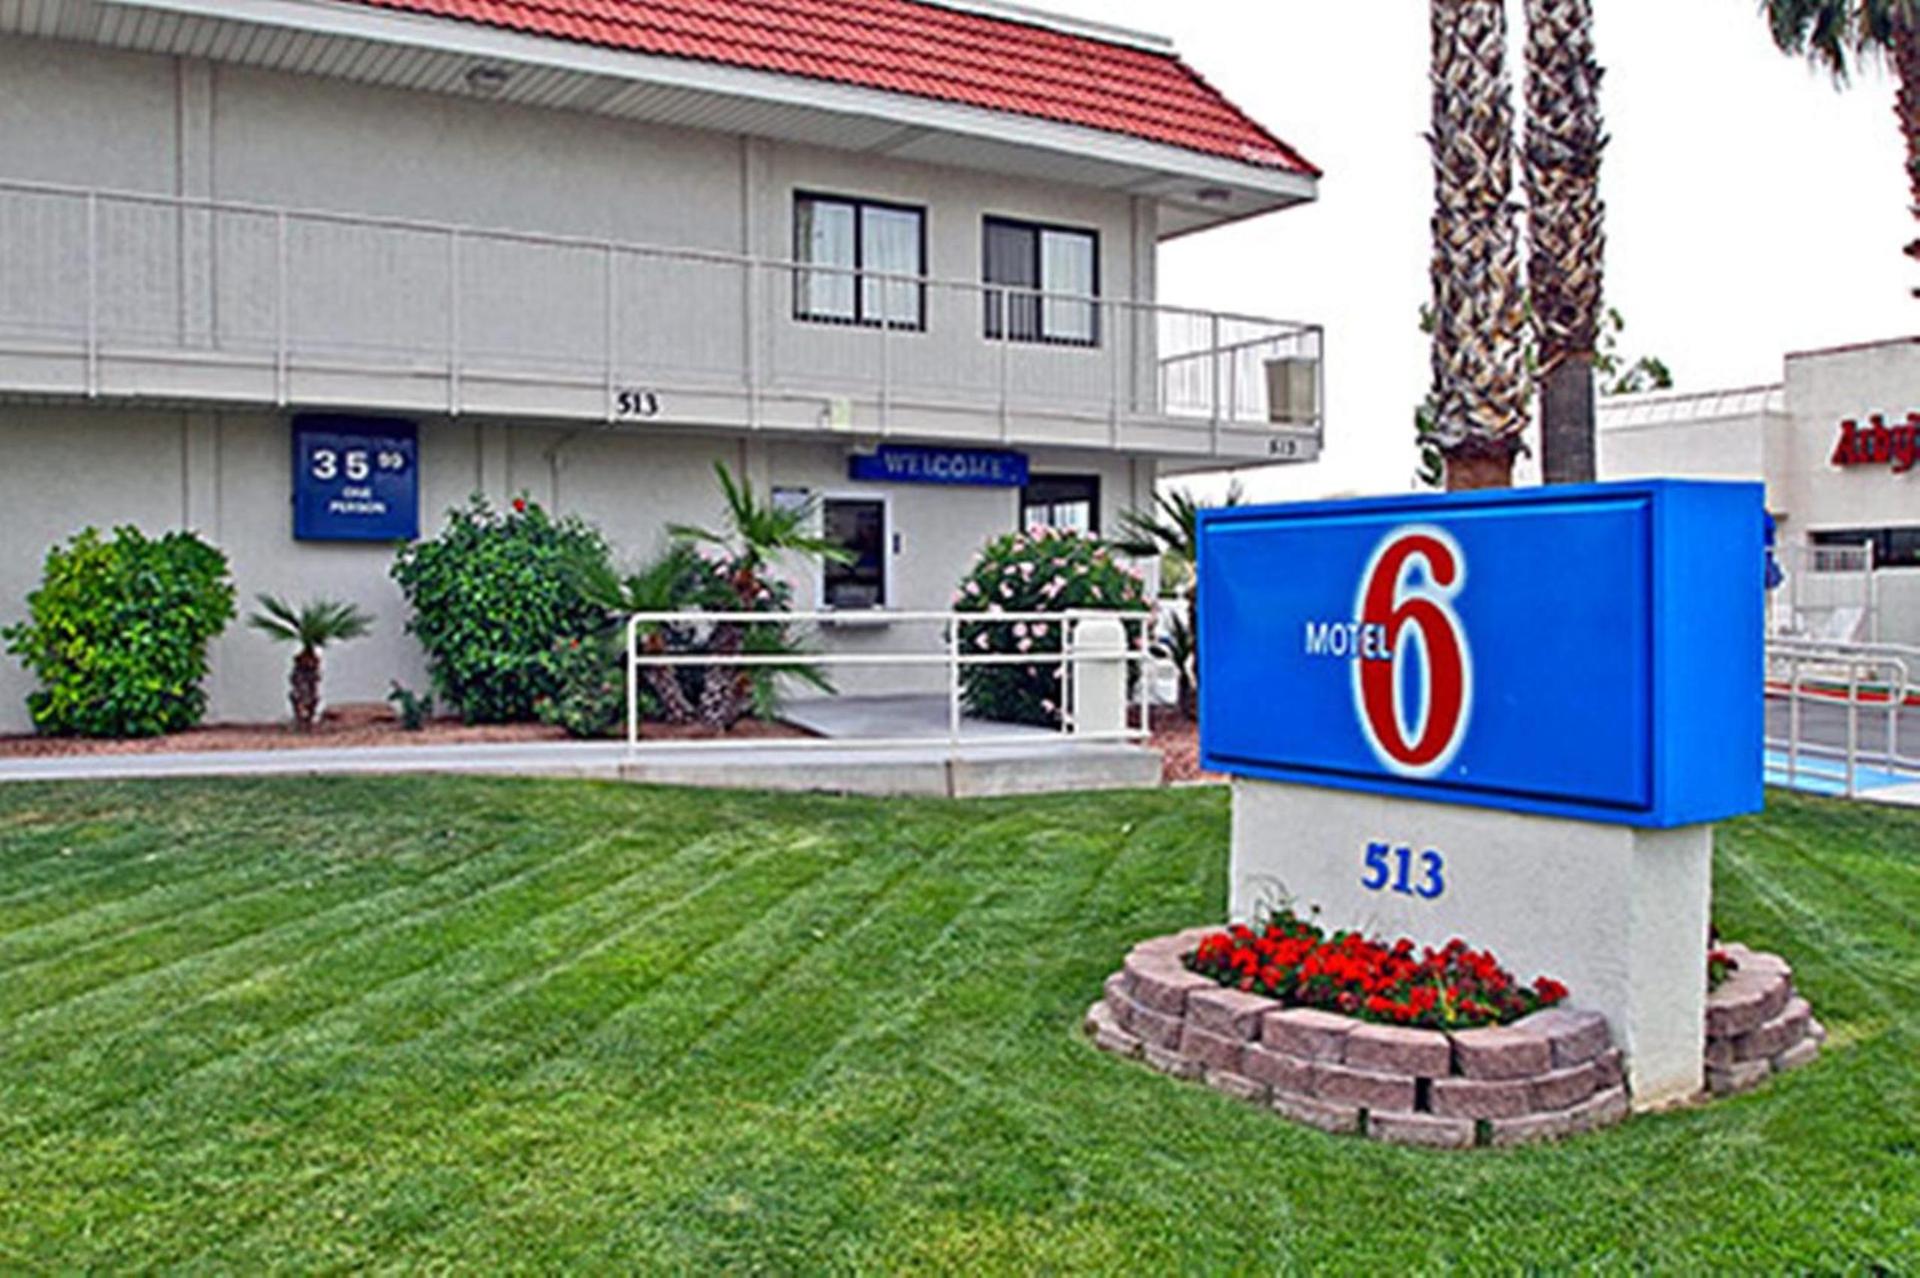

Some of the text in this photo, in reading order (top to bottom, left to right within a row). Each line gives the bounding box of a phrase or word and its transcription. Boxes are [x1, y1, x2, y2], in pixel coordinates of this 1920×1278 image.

[617, 391, 659, 417] 513
[884, 452, 1004, 479] WELCOME
[1305, 523, 1473, 779] MOTEL 6
[1361, 842, 1445, 900] 513
